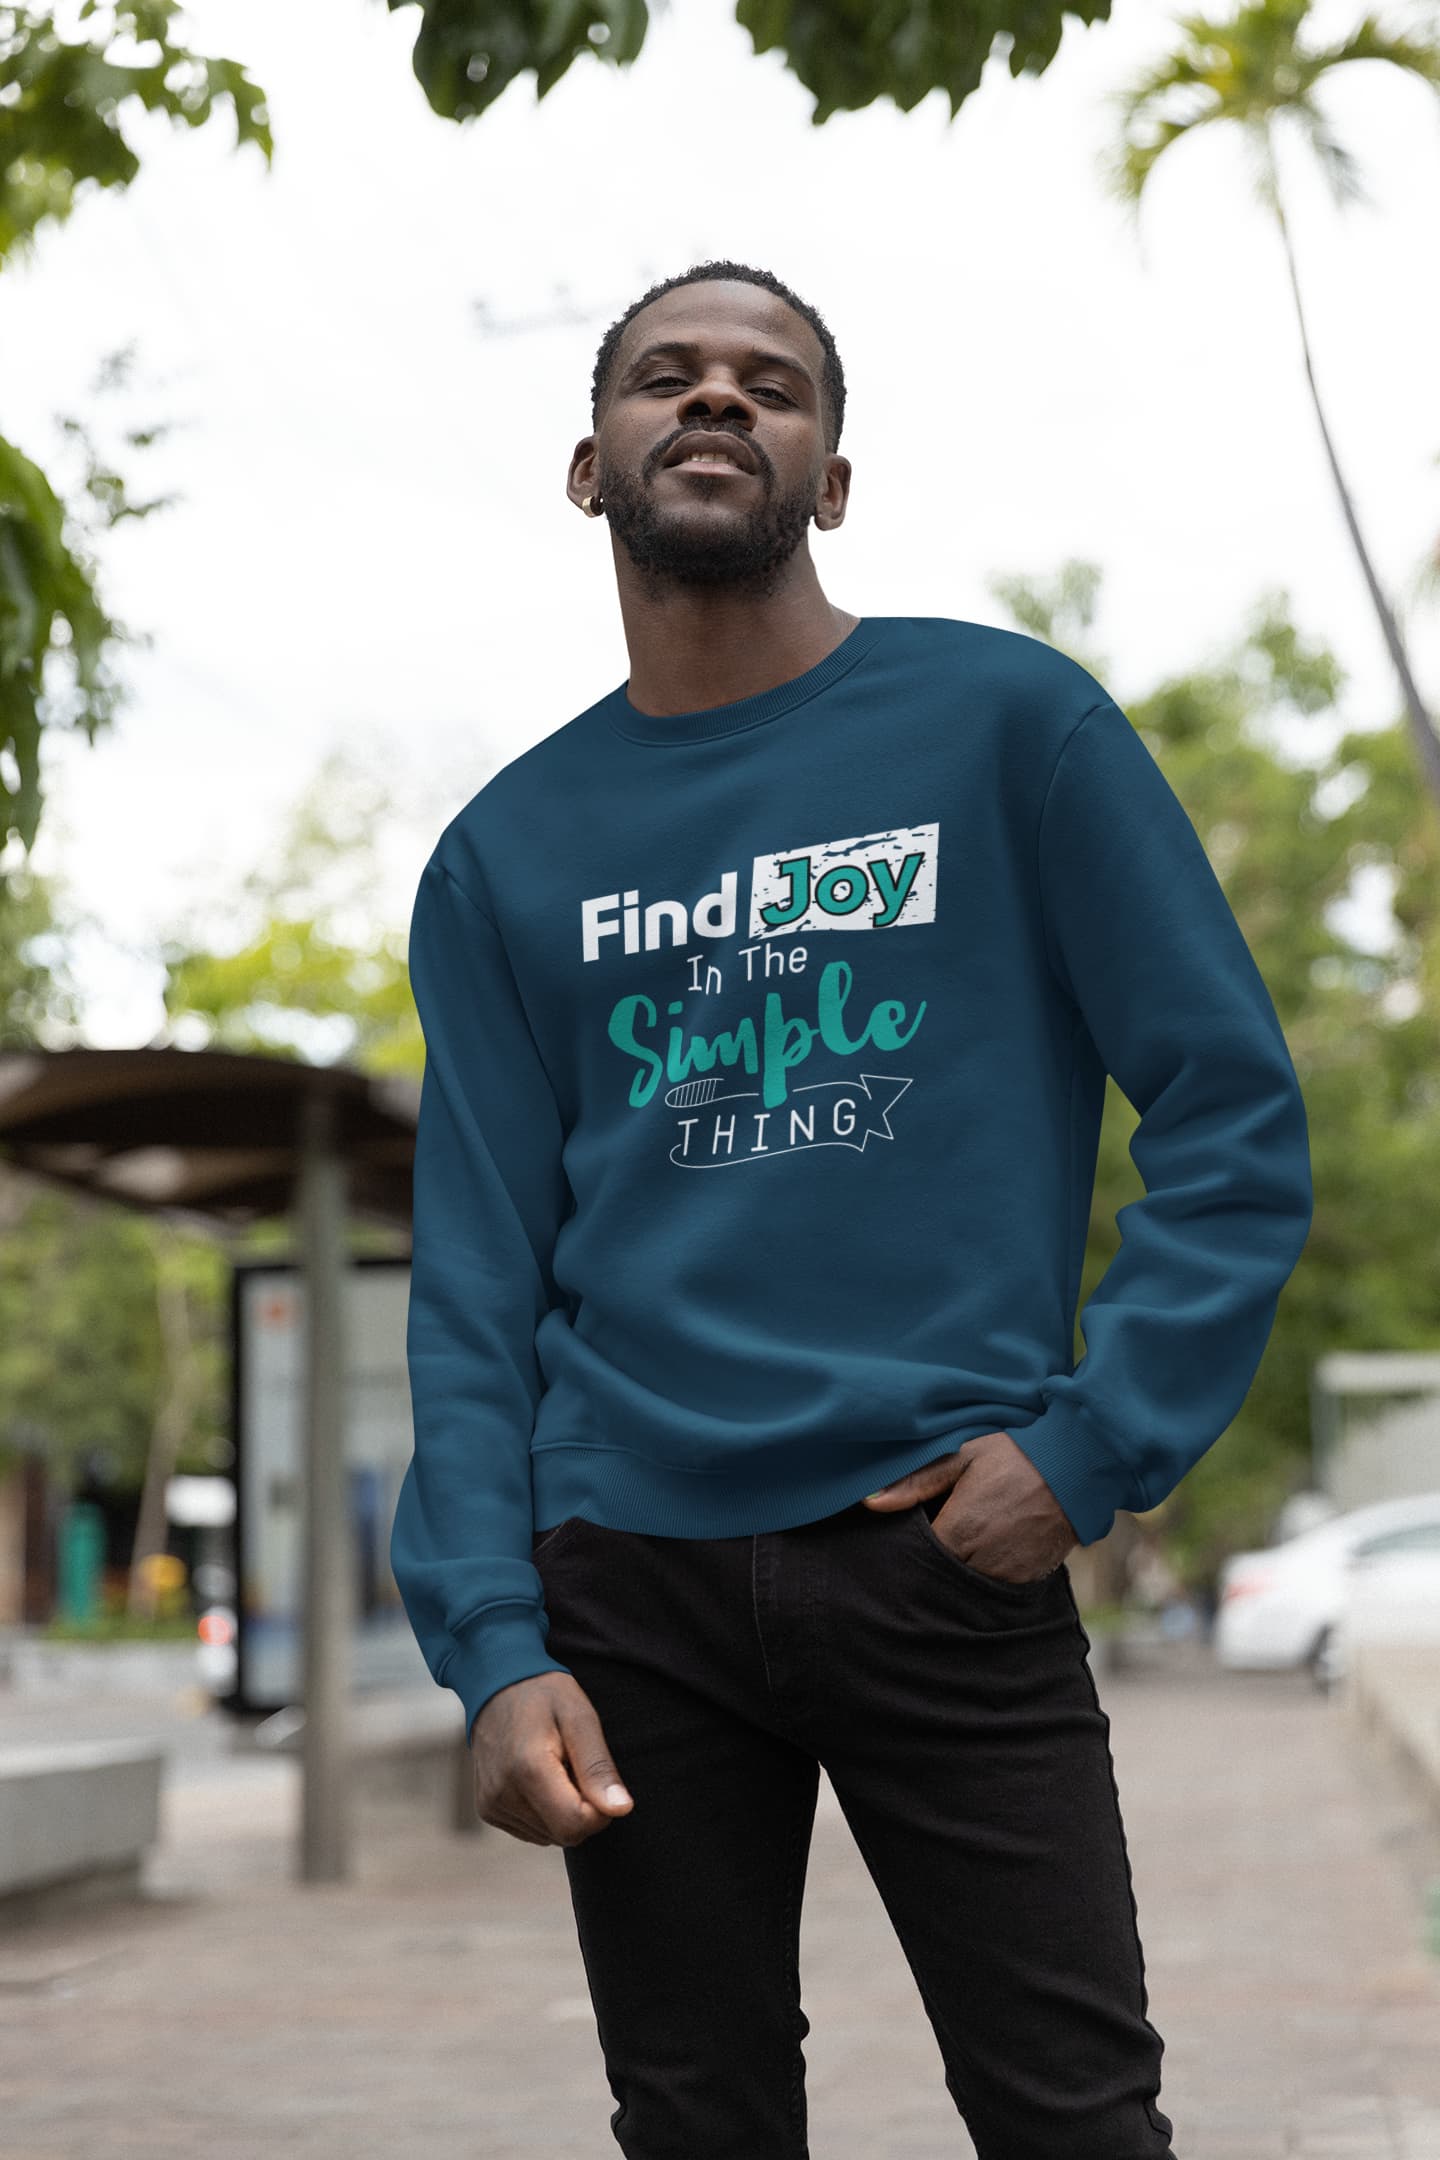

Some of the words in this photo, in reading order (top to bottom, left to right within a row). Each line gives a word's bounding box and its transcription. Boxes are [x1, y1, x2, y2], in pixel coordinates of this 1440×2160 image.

[581, 871, 738, 962] Find
[760, 852, 925, 929] Joy
[687, 955, 722, 995] In
[738, 943, 808, 981] The
[607, 961, 927, 1109] Simple
[678, 1099, 856, 1156] THING
